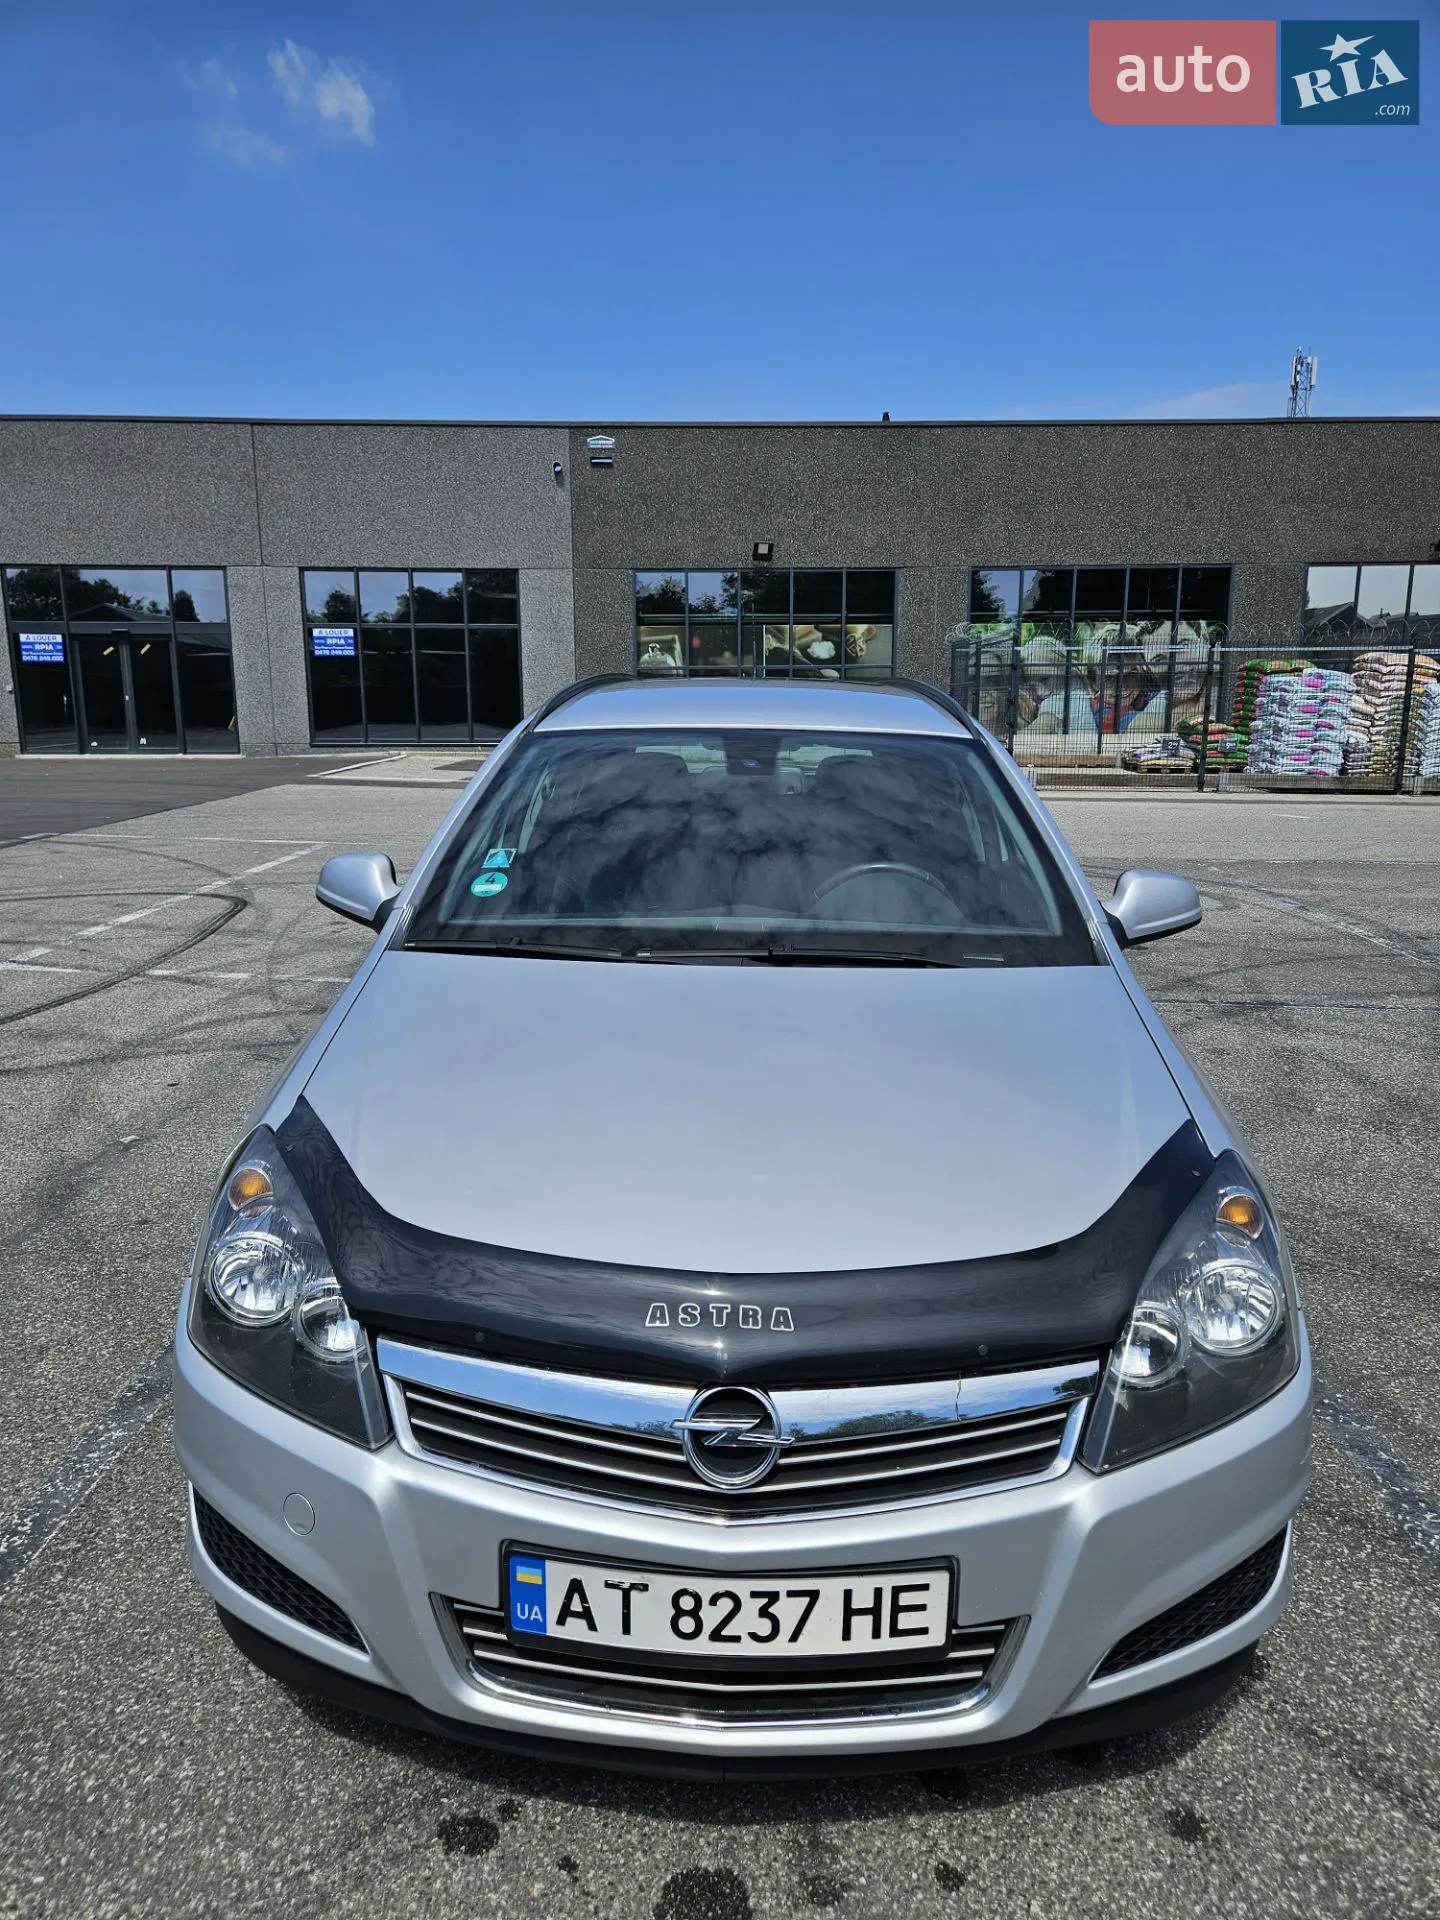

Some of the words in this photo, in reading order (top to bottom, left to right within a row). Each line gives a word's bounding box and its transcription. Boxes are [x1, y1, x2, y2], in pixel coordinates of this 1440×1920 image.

[35, 643, 54, 651] RPIA
[485, 872, 497, 884] 4
[645, 1302, 794, 1331] ASTRA
[516, 1602, 544, 1622] UA
[555, 1576, 649, 1636] AT
[670, 1587, 821, 1644] 8237
[841, 1582, 931, 1642] HE
